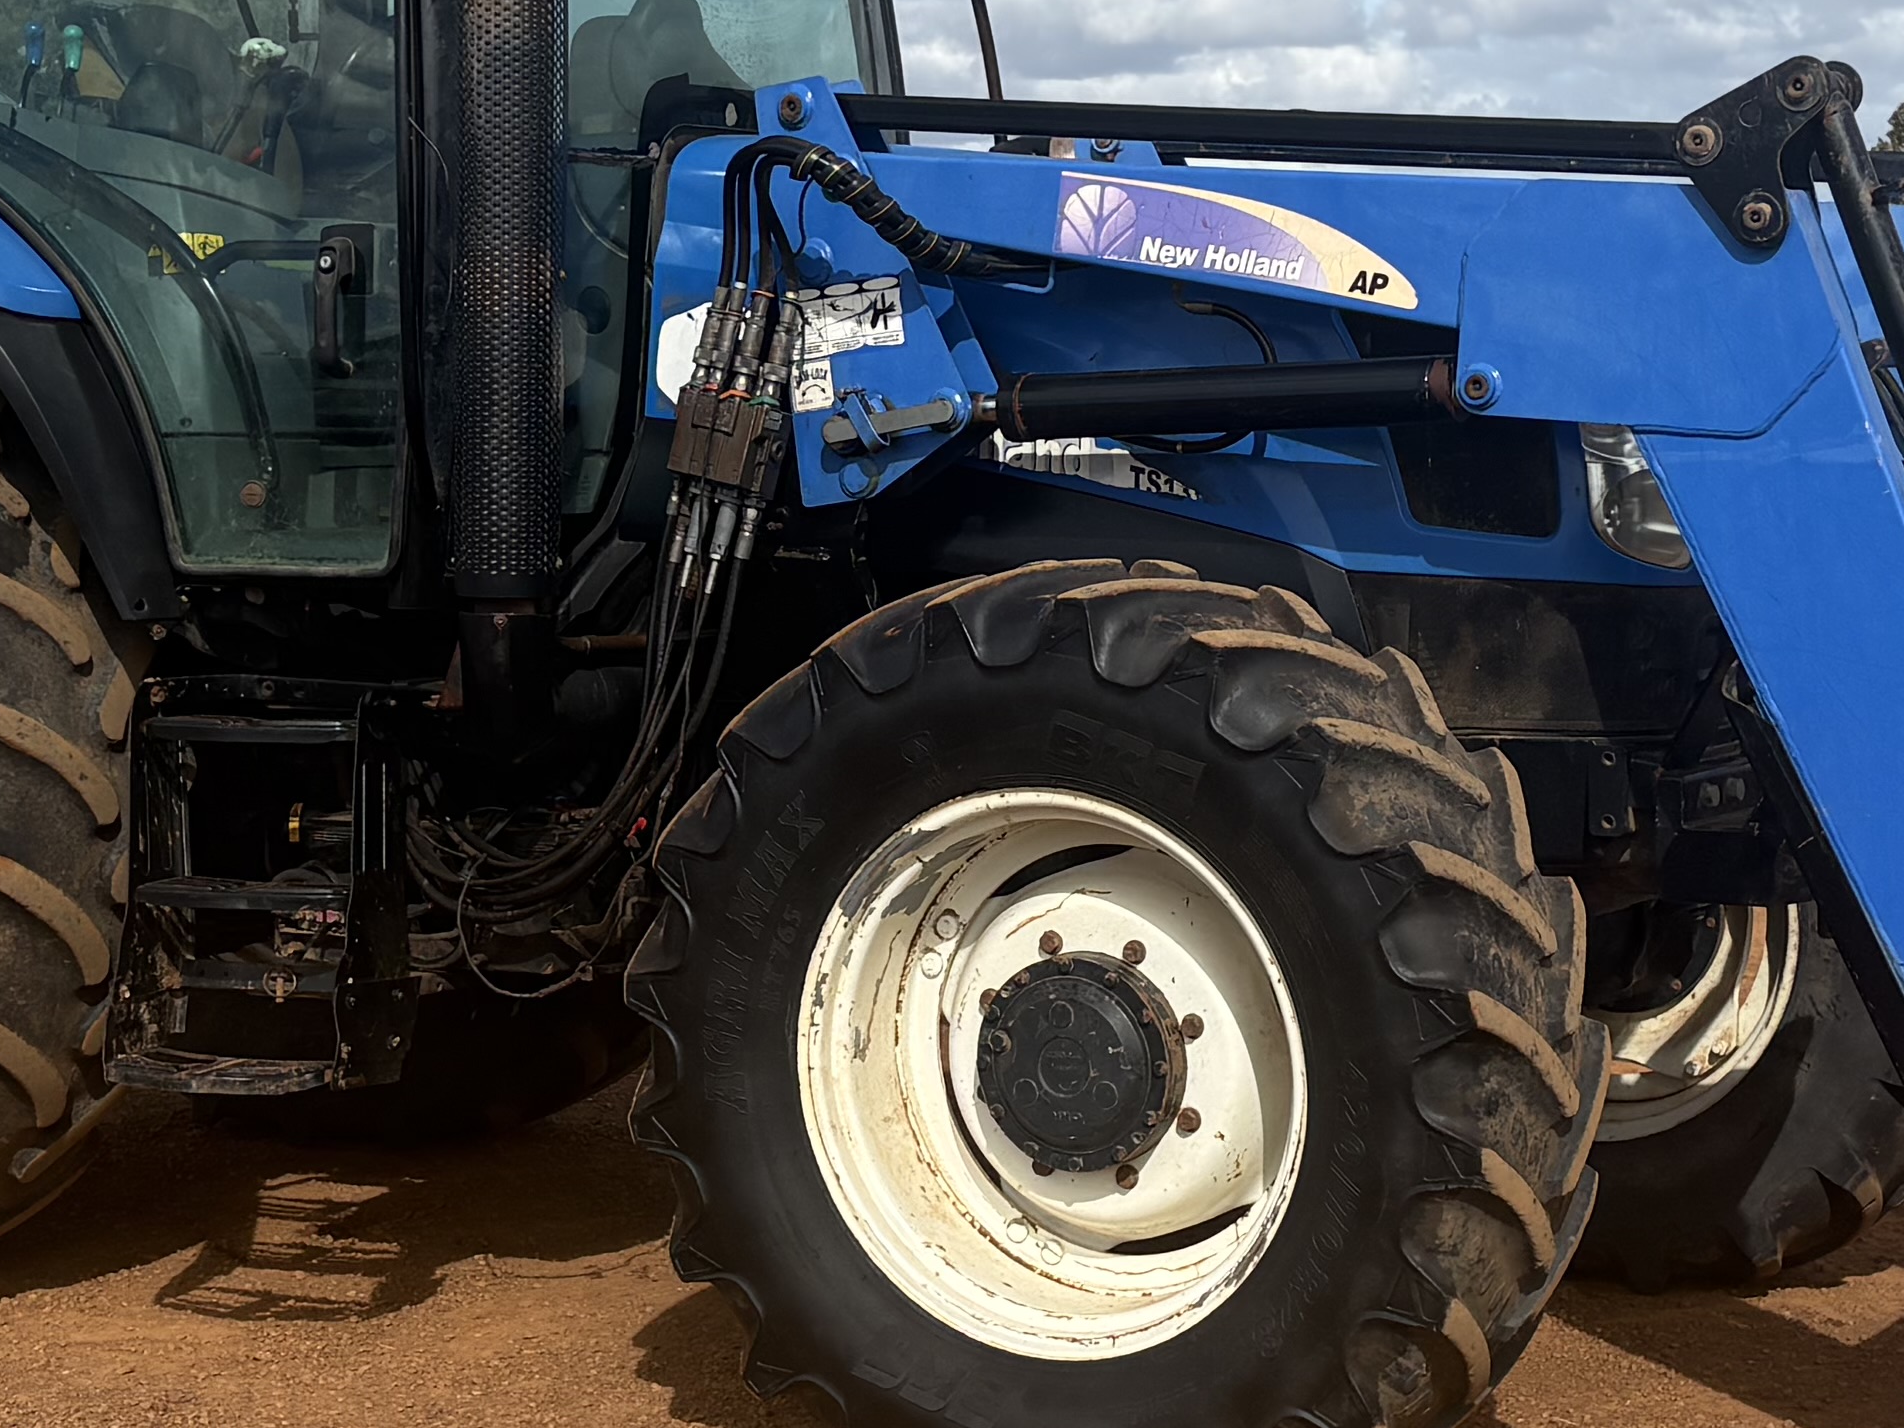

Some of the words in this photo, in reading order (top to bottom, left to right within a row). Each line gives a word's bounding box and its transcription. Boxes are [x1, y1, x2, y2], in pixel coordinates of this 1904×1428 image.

[1139, 235, 1198, 269] New
[1203, 243, 1305, 281] Holland
[1347, 270, 1390, 296] AP
[1042, 708, 1207, 804] BKT
